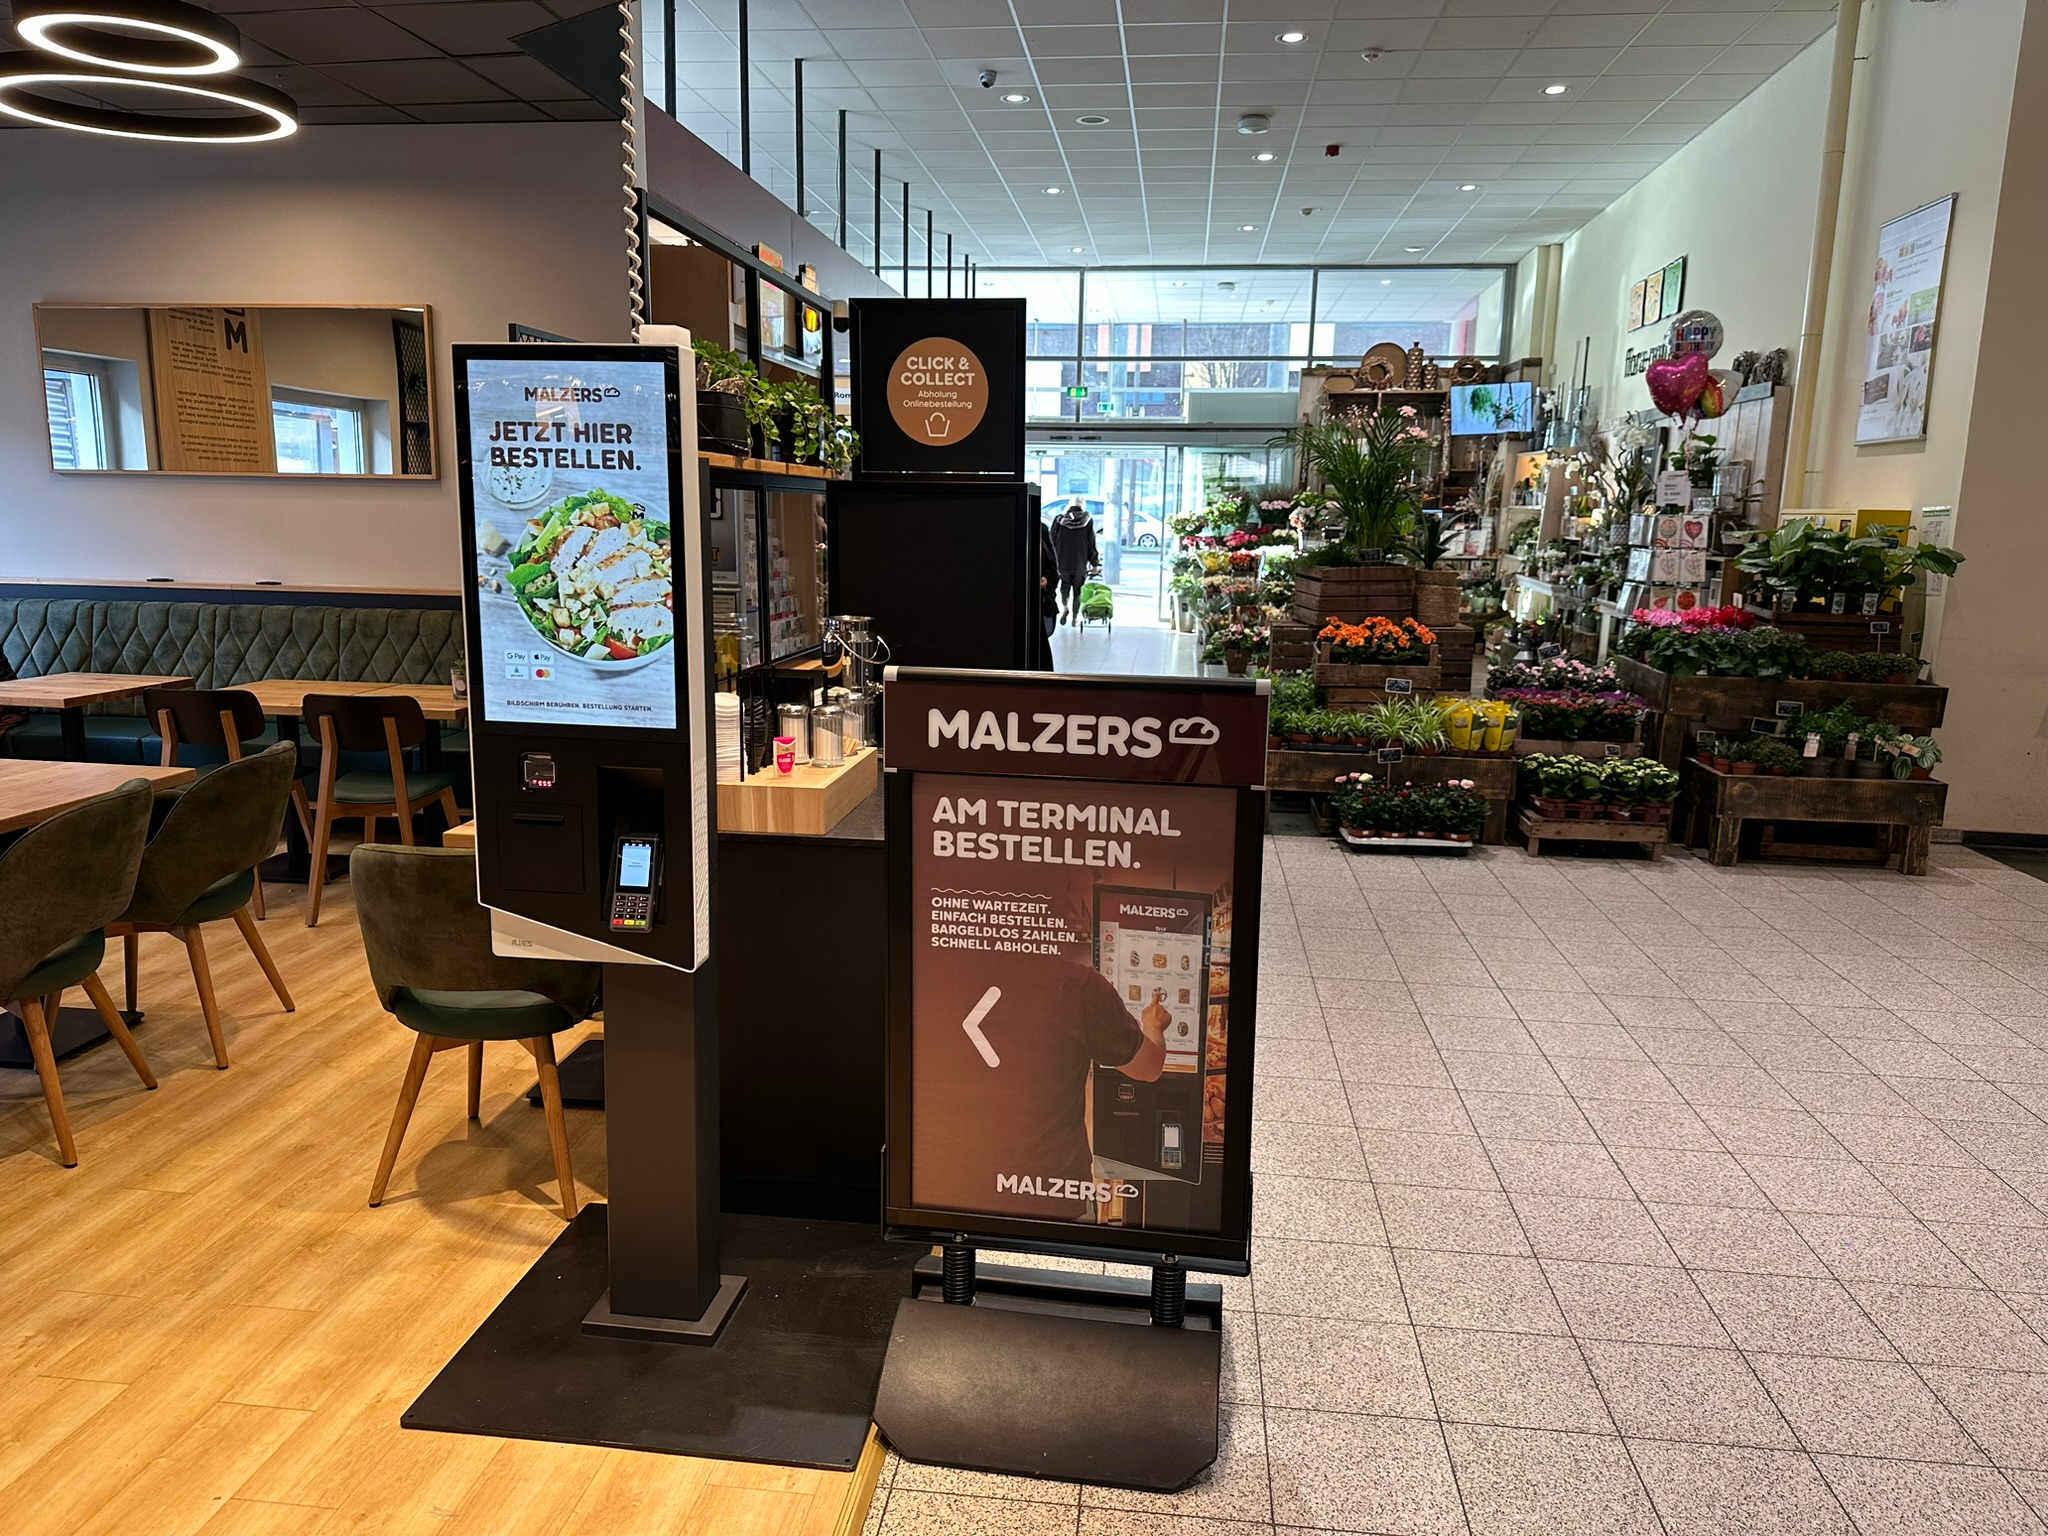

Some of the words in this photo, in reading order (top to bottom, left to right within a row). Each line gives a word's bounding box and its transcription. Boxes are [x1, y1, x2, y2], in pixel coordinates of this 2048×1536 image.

[1676, 327, 1713, 341] HAPPY
[906, 356, 954, 370] CLICK
[958, 356, 970, 370] &
[900, 372, 975, 386] COLLECT
[524, 386, 603, 403] MALZERS
[918, 390, 958, 400] Abholung
[903, 399, 973, 409] Onlinebestellung
[489, 420, 566, 443] JETZT
[574, 422, 632, 445] HIER
[490, 446, 642, 472] BESTELLEN.
[506, 699, 545, 707] BILDSCHIRM
[582, 702, 623, 711] BESTELLUNG
[928, 709, 1162, 757] MALZERS
[932, 796, 987, 826] AM
[997, 801, 1180, 836] TERMINAL
[933, 831, 1140, 868] BESTELLEN.
[931, 897, 969, 911] OHNE
[972, 898, 1052, 916] WARTEZEIT.
[1119, 904, 1176, 920] MALZERS
[931, 911, 987, 925] EINFACH
[989, 912, 1068, 929] BESTELLEN.
[931, 923, 1019, 940] BARGELDLOS
[1022, 926, 1079, 944] ZAHLEN.
[931, 936, 992, 952] SCHNELL
[994, 940, 1062, 956] ABHOLEN.
[996, 1174, 1111, 1201] MALZERS
